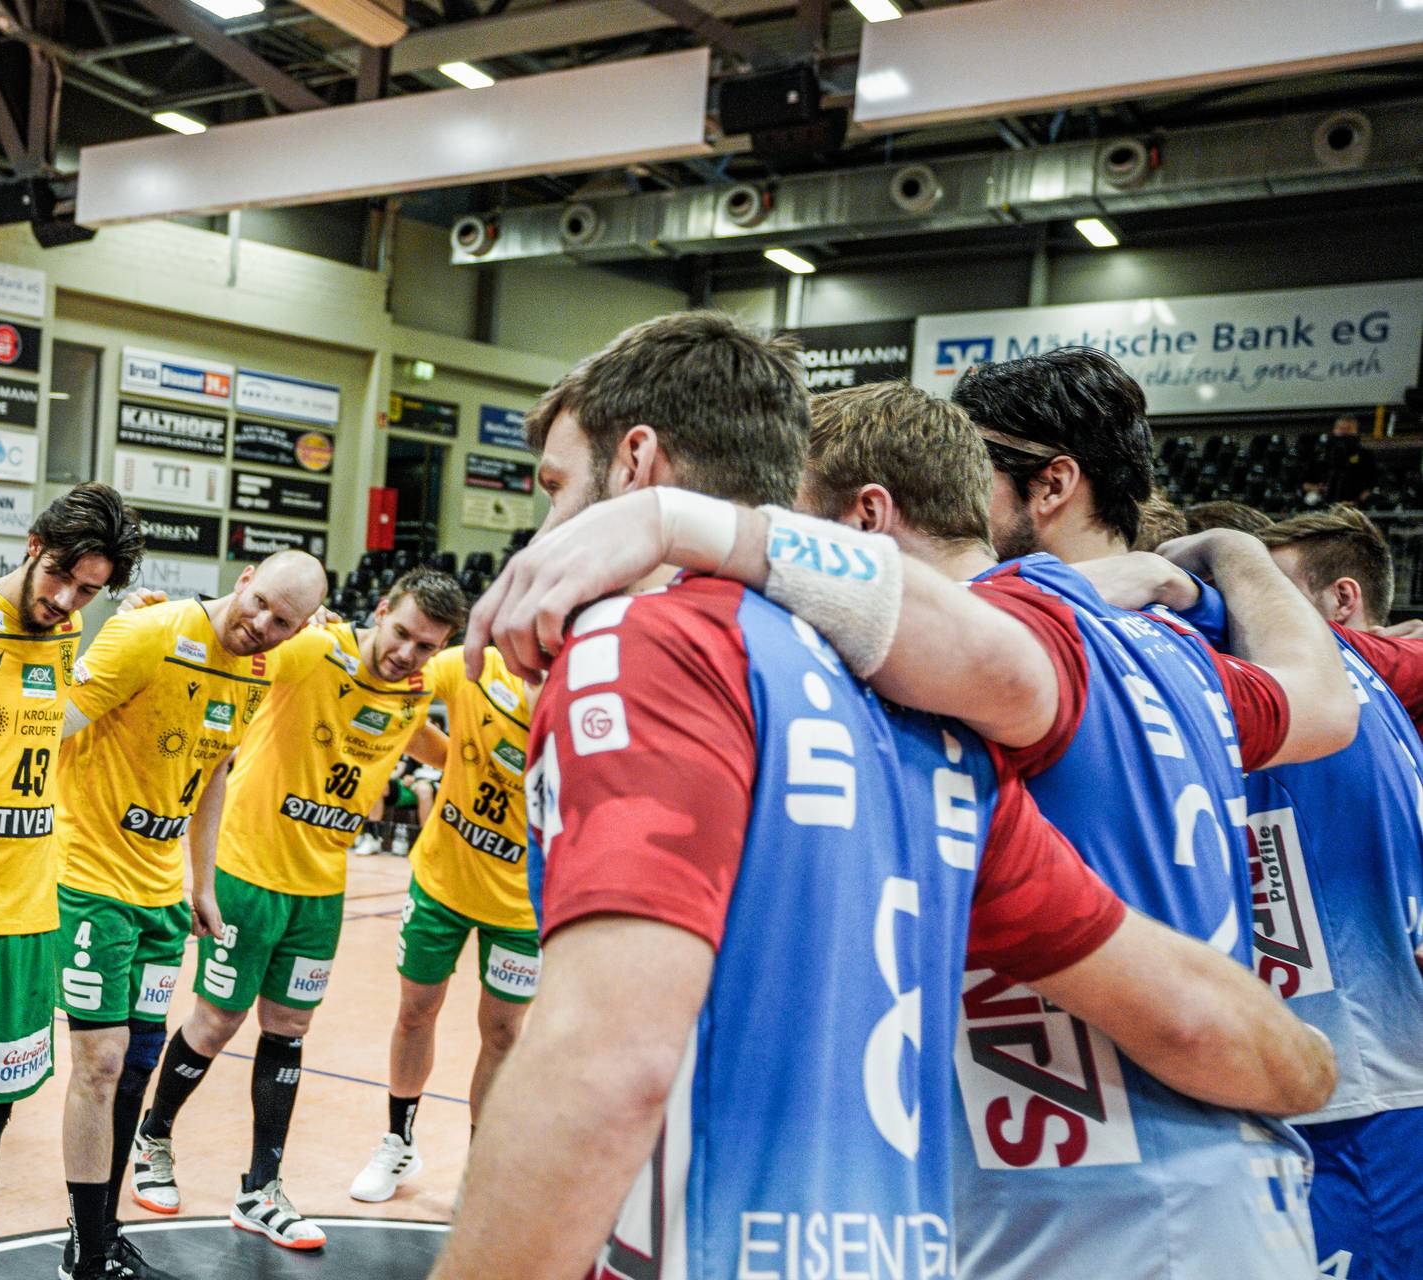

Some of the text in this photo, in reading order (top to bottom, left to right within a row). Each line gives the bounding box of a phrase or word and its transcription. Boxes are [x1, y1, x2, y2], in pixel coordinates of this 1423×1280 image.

[1213, 315, 1314, 354] Bank
[1331, 309, 1393, 346] eG
[795, 345, 908, 368] OLLMANN
[803, 368, 855, 388] UPPE
[120, 407, 225, 440] KALTHOFF
[27, 667, 52, 682] AOK
[20, 725, 57, 737] GRUPPE
[23, 709, 65, 722] KROLLMA
[11, 747, 51, 798] 43
[178, 768, 203, 808] 4
[324, 762, 361, 800] 36
[302, 803, 362, 834] TIVELA
[472, 781, 510, 825] 33
[458, 816, 523, 863] TIVELA
[1258, 825, 1286, 903] Profile
[74, 920, 92, 949] 4
[490, 964, 537, 988] HOFFM
[3, 1037, 49, 1066] Getränk
[738, 1211, 958, 1280] EISENG
